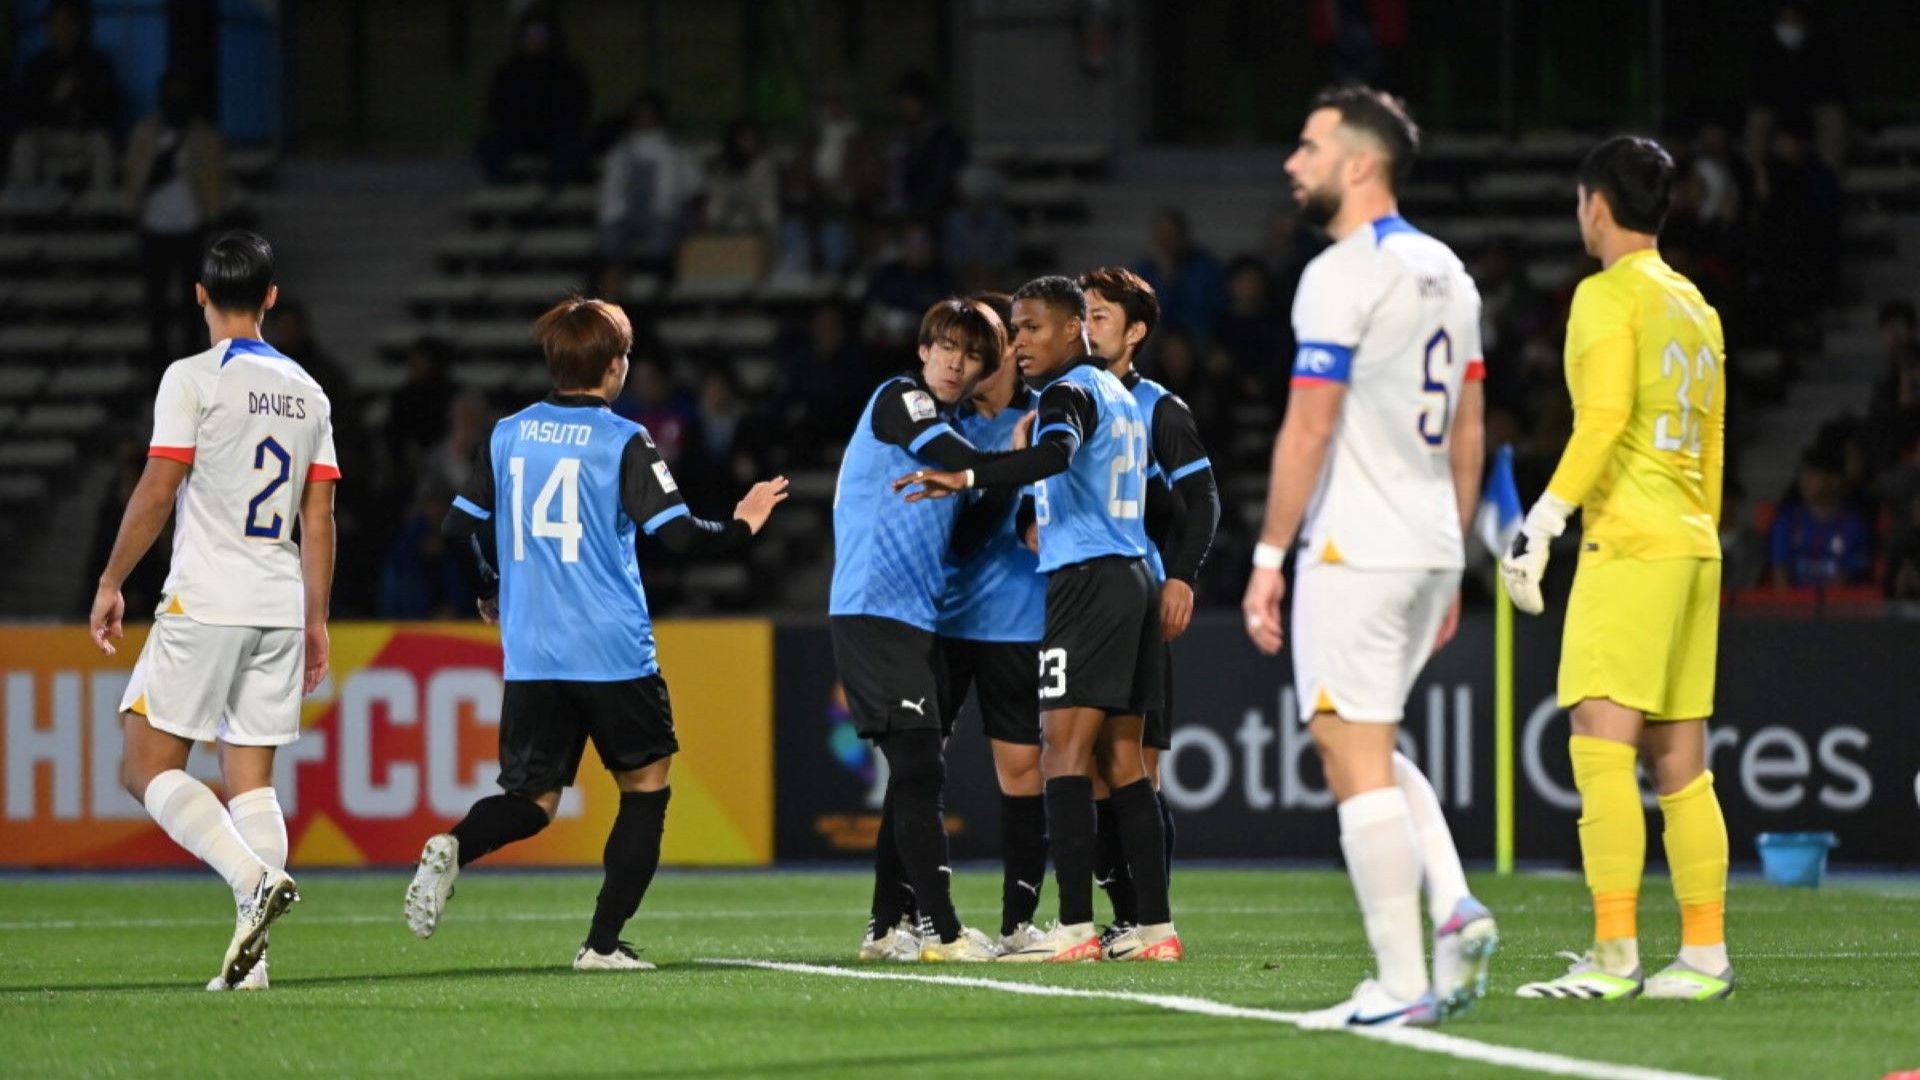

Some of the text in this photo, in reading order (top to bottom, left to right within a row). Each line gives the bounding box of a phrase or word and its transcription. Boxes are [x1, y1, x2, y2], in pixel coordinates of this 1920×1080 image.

[248, 391, 306, 420] DAVIES
[519, 419, 593, 448] YASUTO
[1418, 325, 1455, 447] 5
[243, 434, 292, 541] 2
[508, 456, 583, 563] 14
[1520, 693, 1874, 812] Cres
